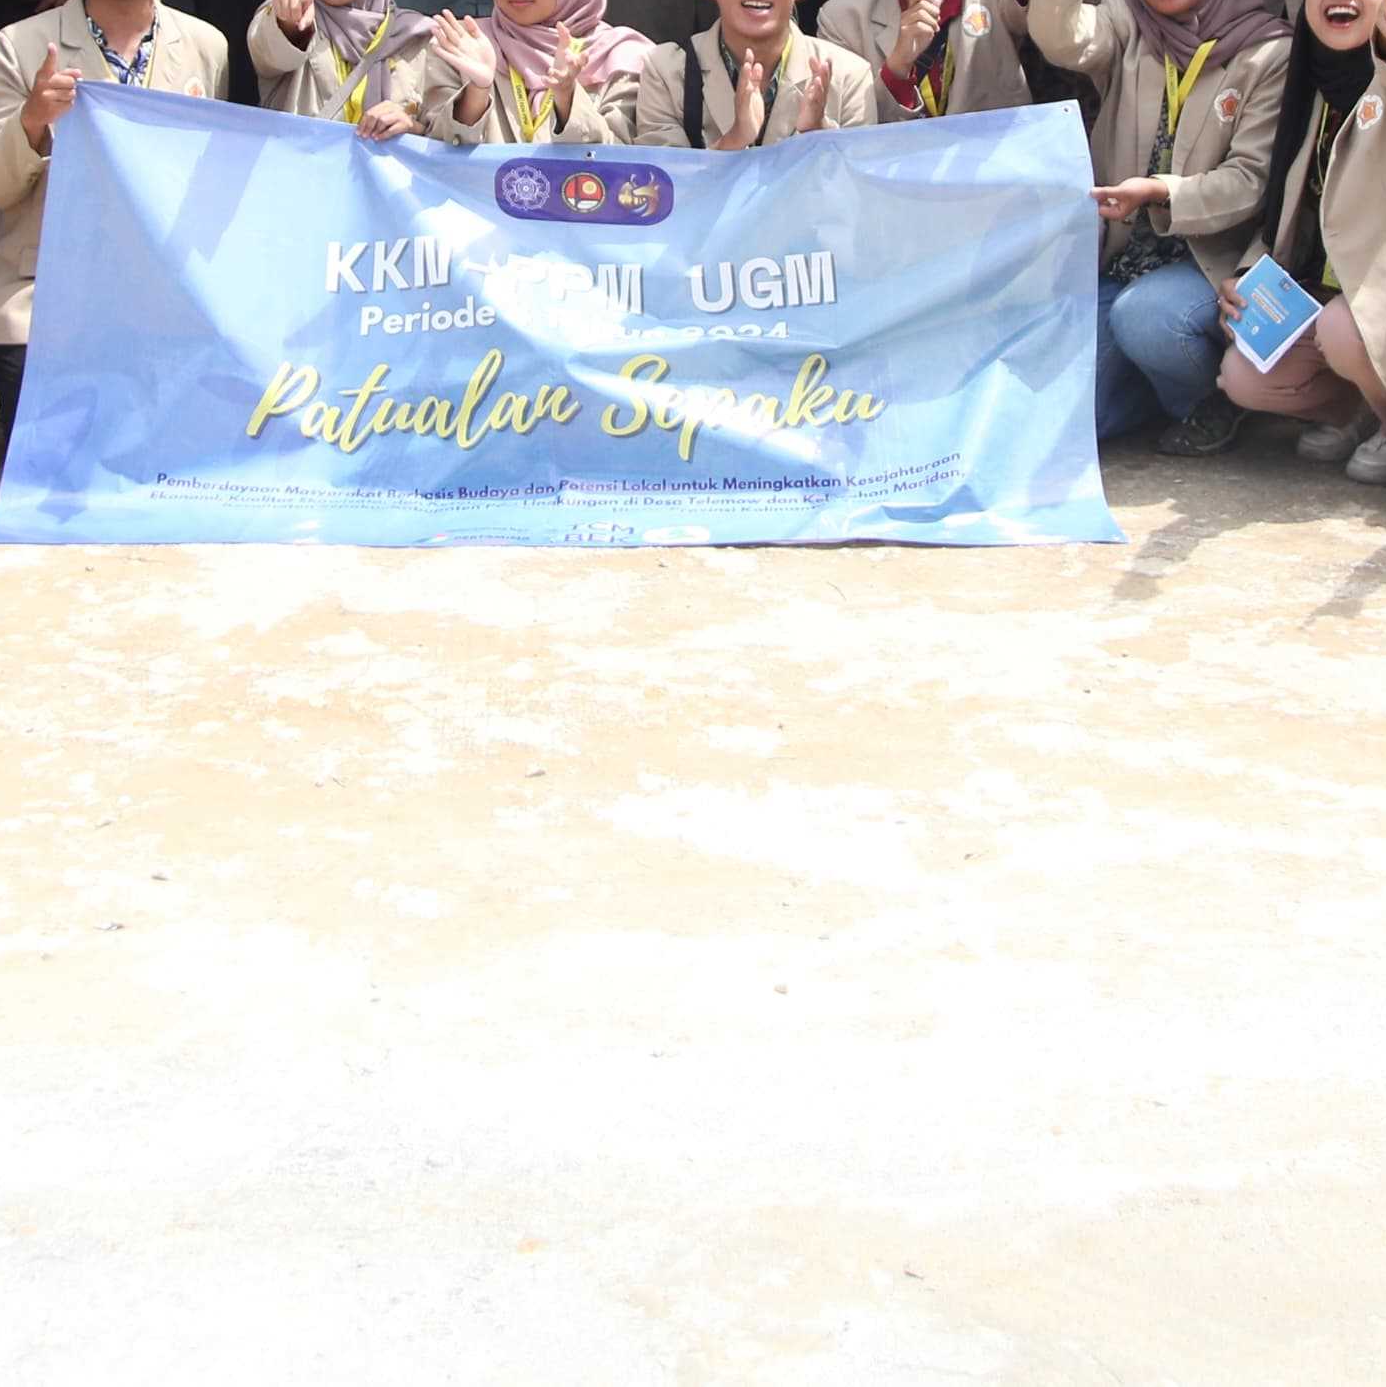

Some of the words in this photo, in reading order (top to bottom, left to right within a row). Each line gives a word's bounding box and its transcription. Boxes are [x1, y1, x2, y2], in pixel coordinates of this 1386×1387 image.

[688, 250, 839, 315] UGM
[359, 295, 497, 337] Periode
[245, 348, 582, 455] Patualan
[600, 352, 887, 463] Sepaku
[156, 472, 282, 496] Pemberdayaan
[457, 484, 520, 501] Budaya
[521, 481, 555, 496] dan
[558, 478, 618, 493] Potensi
[621, 478, 667, 493] Lokal
[670, 477, 718, 492] untuk
[722, 473, 842, 493] Meningkatkan
[845, 452, 962, 488] Kesejahteraan
[766, 494, 799, 505] dan
